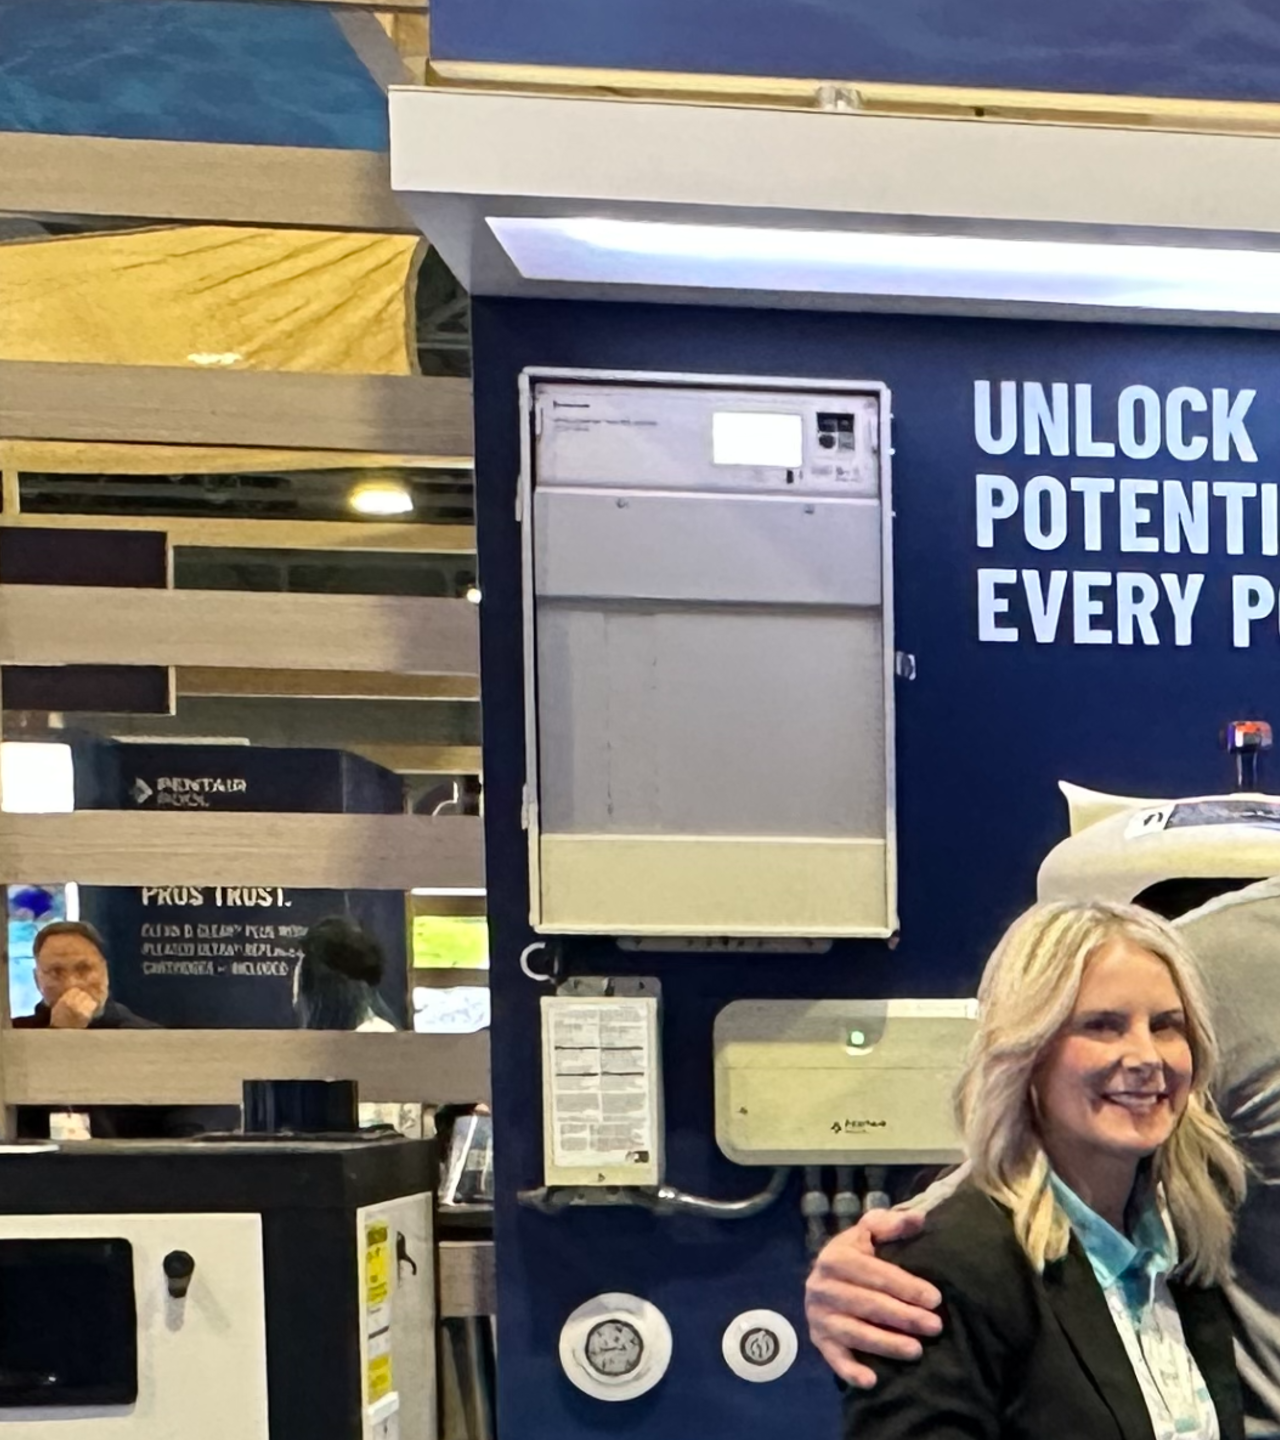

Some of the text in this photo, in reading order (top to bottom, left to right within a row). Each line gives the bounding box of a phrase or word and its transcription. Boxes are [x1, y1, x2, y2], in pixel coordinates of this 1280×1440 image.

[974, 379, 1258, 462] UNLOCK
[977, 568, 1205, 643] EVERY
[141, 886, 204, 906] PROS
